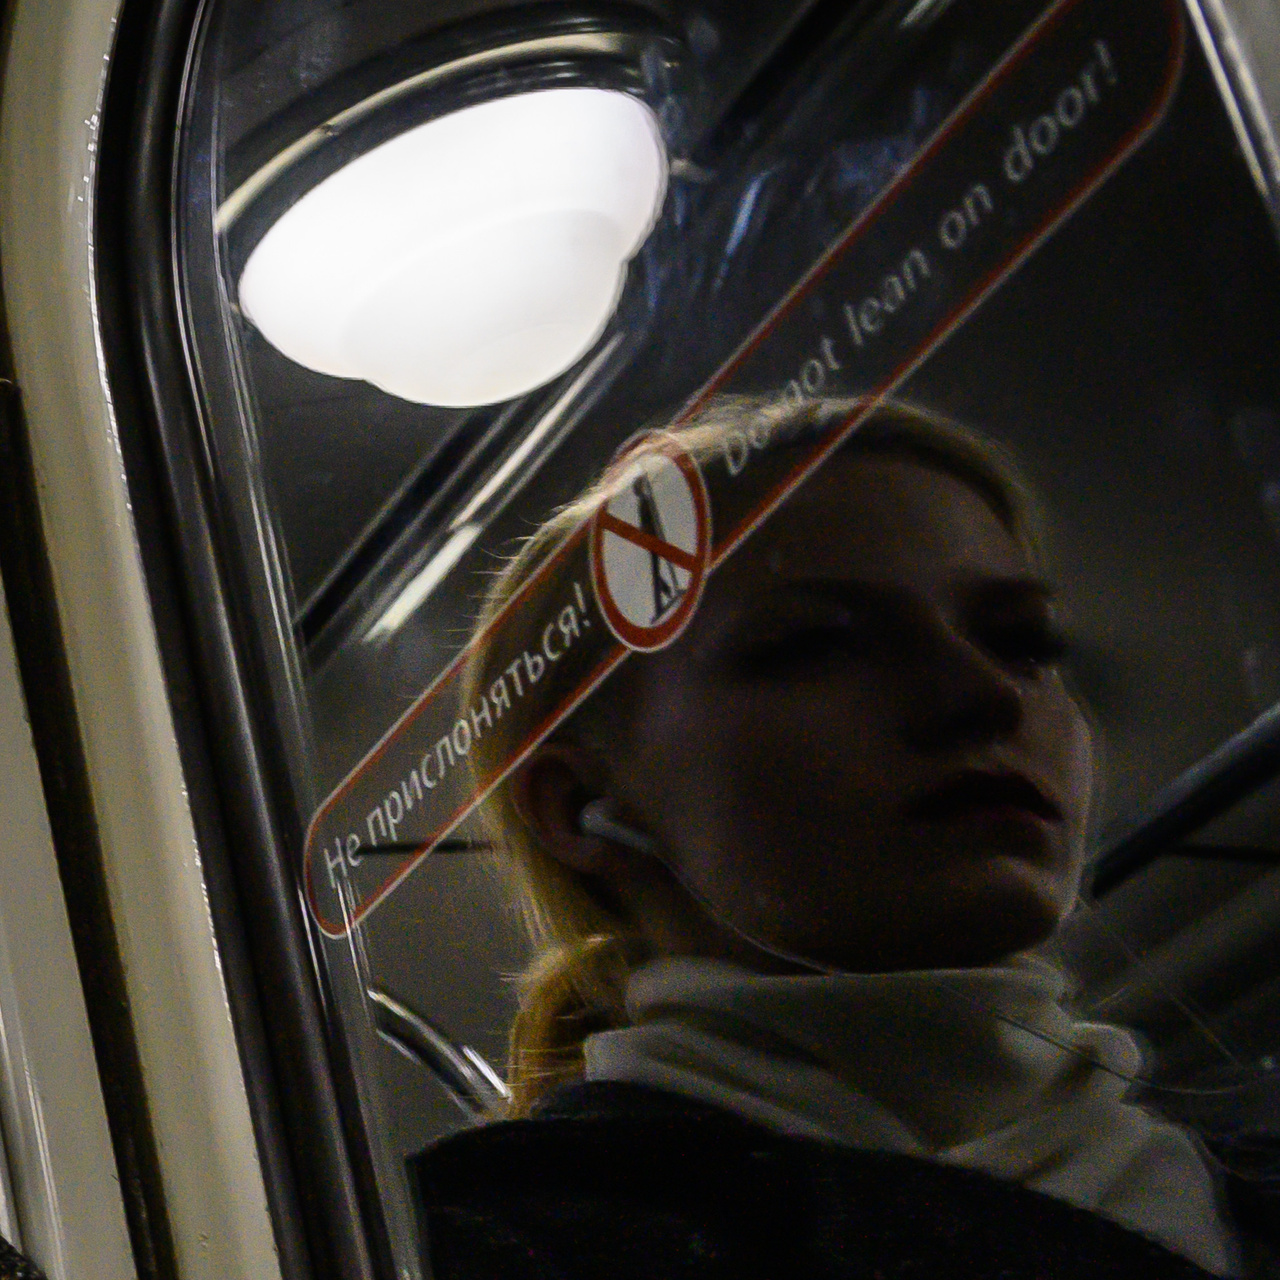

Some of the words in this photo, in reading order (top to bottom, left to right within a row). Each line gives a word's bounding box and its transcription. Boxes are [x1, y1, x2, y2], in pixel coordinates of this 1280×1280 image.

[845, 250, 931, 346] lean
[939, 183, 993, 248] on
[1003, 38, 1117, 182] door!
[323, 833, 363, 888] Не
